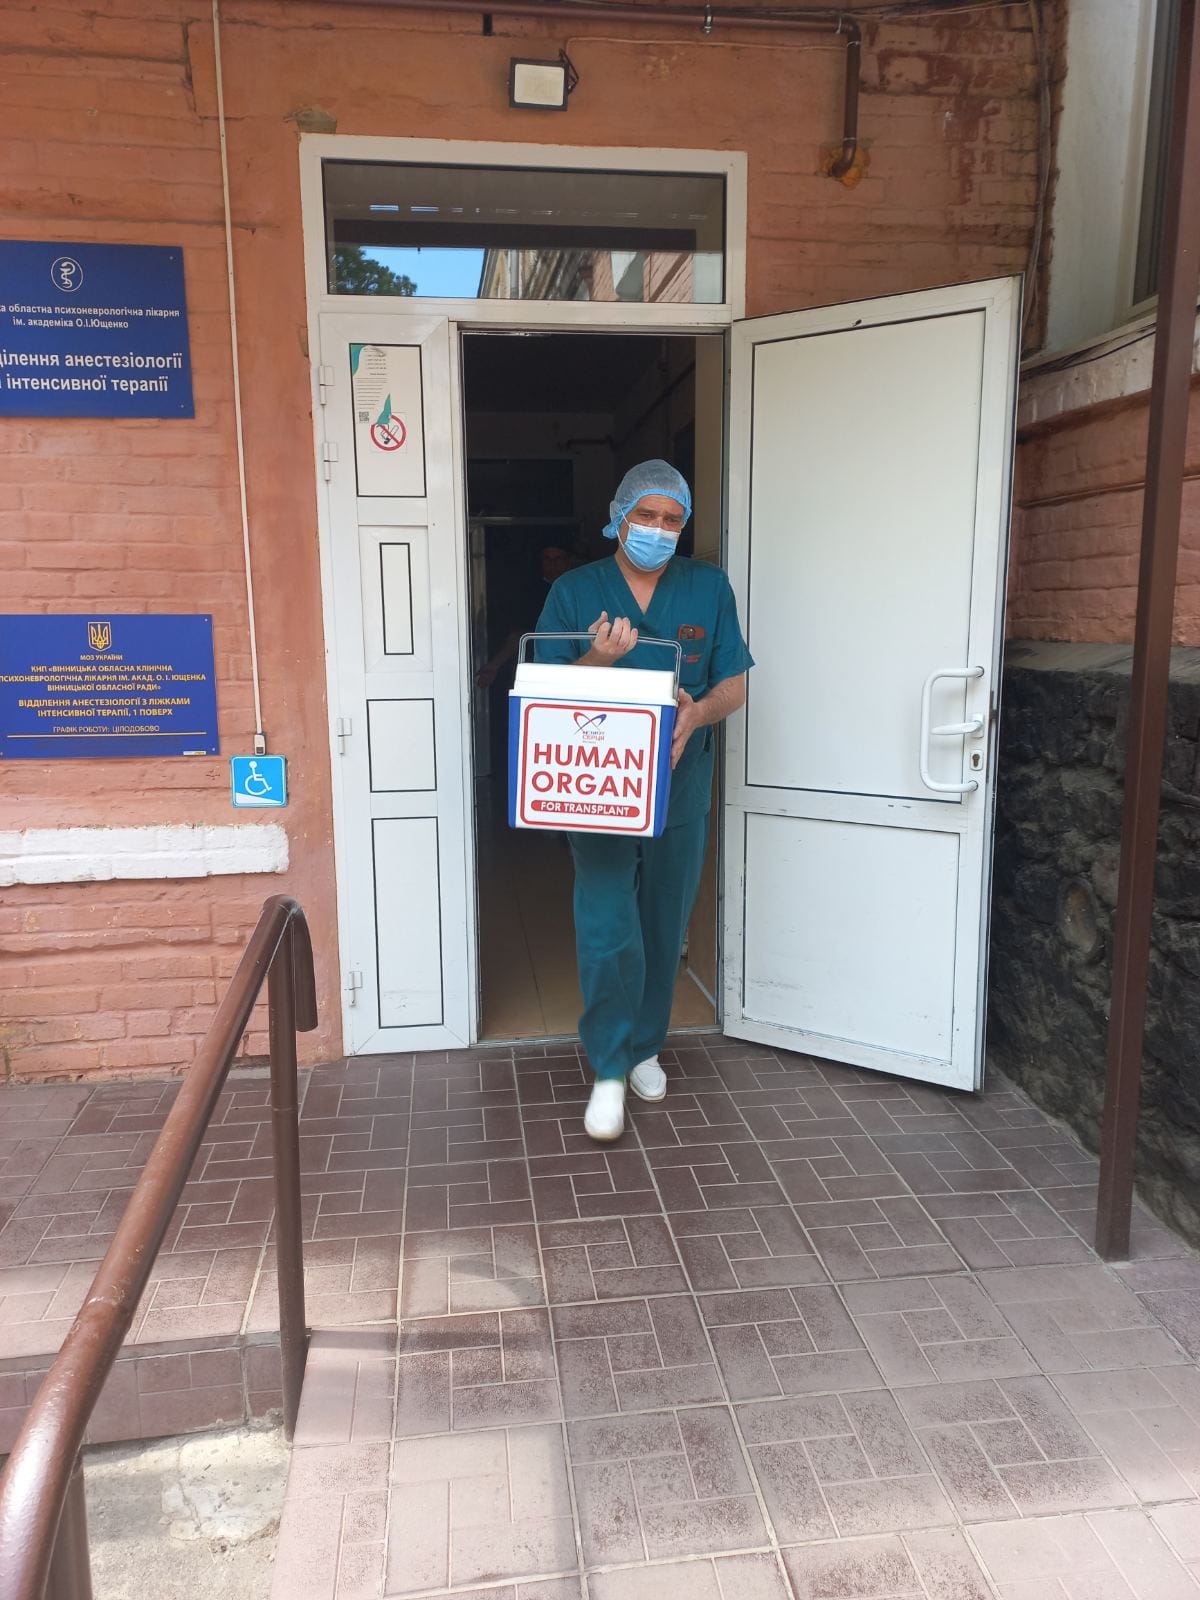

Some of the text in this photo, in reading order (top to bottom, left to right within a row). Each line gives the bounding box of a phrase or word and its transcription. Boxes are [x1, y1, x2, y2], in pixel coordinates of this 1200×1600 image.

[8, 304, 52, 314] областна
[54, 306, 143, 317] психоневрологічна
[145, 307, 180, 318] лікарня
[12, 316, 129, 329] ім. академіка О.І.Ющенко
[64, 352, 183, 369] анестезіології
[6, 373, 107, 391] інтенсивної
[111, 376, 168, 395] терапії
[95, 653, 123, 661] УКРАЇНИ
[31, 665, 47, 673] КНП
[84, 674, 117, 682] ЛІКАРНЯ
[131, 674, 155, 682] АКАД.
[171, 674, 206, 682] ЮЩЕНКА
[47, 684, 95, 692] ВІННИЦЬКОЇ
[18, 699, 71, 708] ВІДДІЛЕННЯ
[72, 697, 141, 706] АНЕСТЕЗІОЛОГІЇ
[37, 708, 95, 717] ІНТЕНСИВНОЇ
[96, 708, 131, 717] ТЕРАПІЇ,
[139, 708, 173, 716] ПОВЕРХ
[112, 725, 160, 733] ЦІЛОДОБОВО
[533, 743, 644, 771] HUMAN
[531, 770, 642, 798] ORGAN
[540, 801, 630, 817] FOR TRANSPLANT
